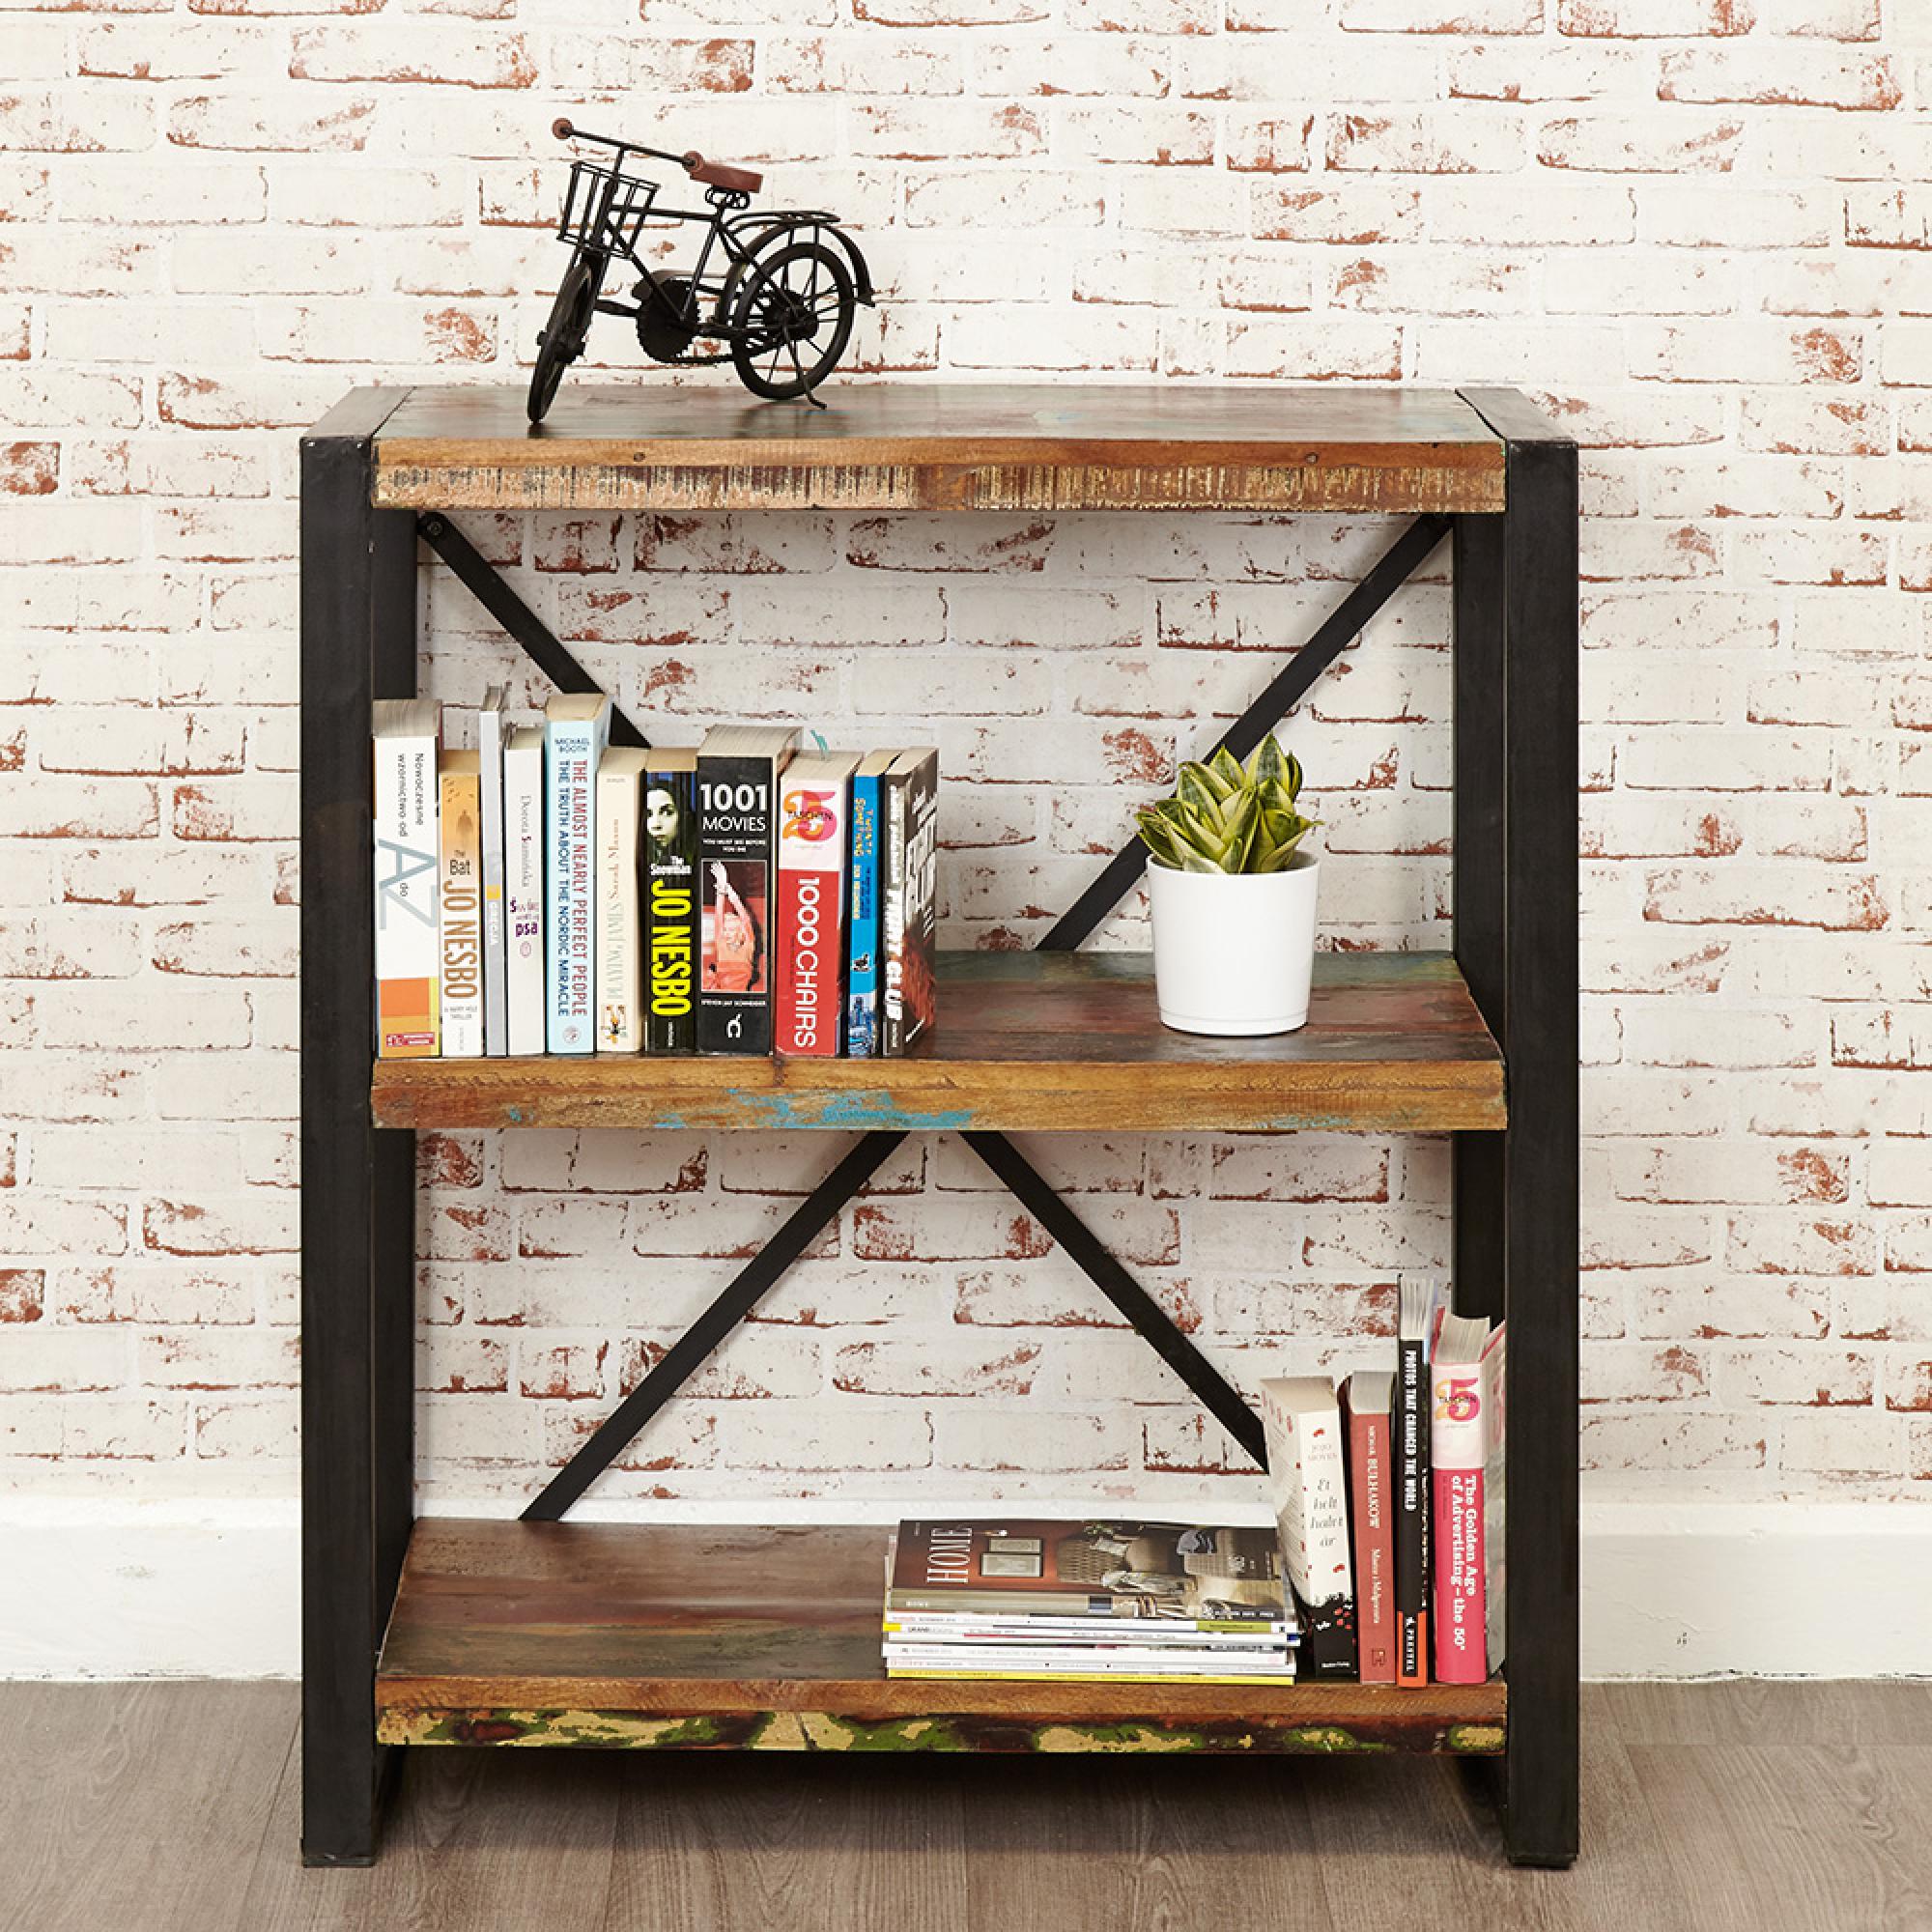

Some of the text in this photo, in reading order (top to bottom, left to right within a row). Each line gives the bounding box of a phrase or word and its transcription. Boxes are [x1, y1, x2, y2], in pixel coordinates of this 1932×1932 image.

[398, 753, 409, 837] wzornictwo od
[414, 753, 424, 825] Nowoczesne
[699, 783, 768, 811] 1001
[702, 815, 766, 832] MOVIES
[378, 838, 438, 929] A do Z
[442, 879, 477, 912] JO
[449, 858, 471, 876] Bat
[557, 759, 570, 1017] THE TRUTH ABOUT THE NORDIC MIRACLE
[572, 759, 588, 1016] THE ALMOST NEARLY PERFECT PEOPLE
[650, 879, 693, 917] JO
[515, 922, 539, 938] psa
[796, 876, 820, 949] 1000
[885, 887, 906, 1021] FIGHT CLUB
[794, 949, 819, 1049] CHAIRS
[1404, 1350, 1417, 1512] PHOTOS THAT CHANGED THE WORLD
[1451, 1475, 1464, 1492] of
[926, 1527, 973, 1583] HOME
[1463, 1475, 1478, 1597] The Golden Age
